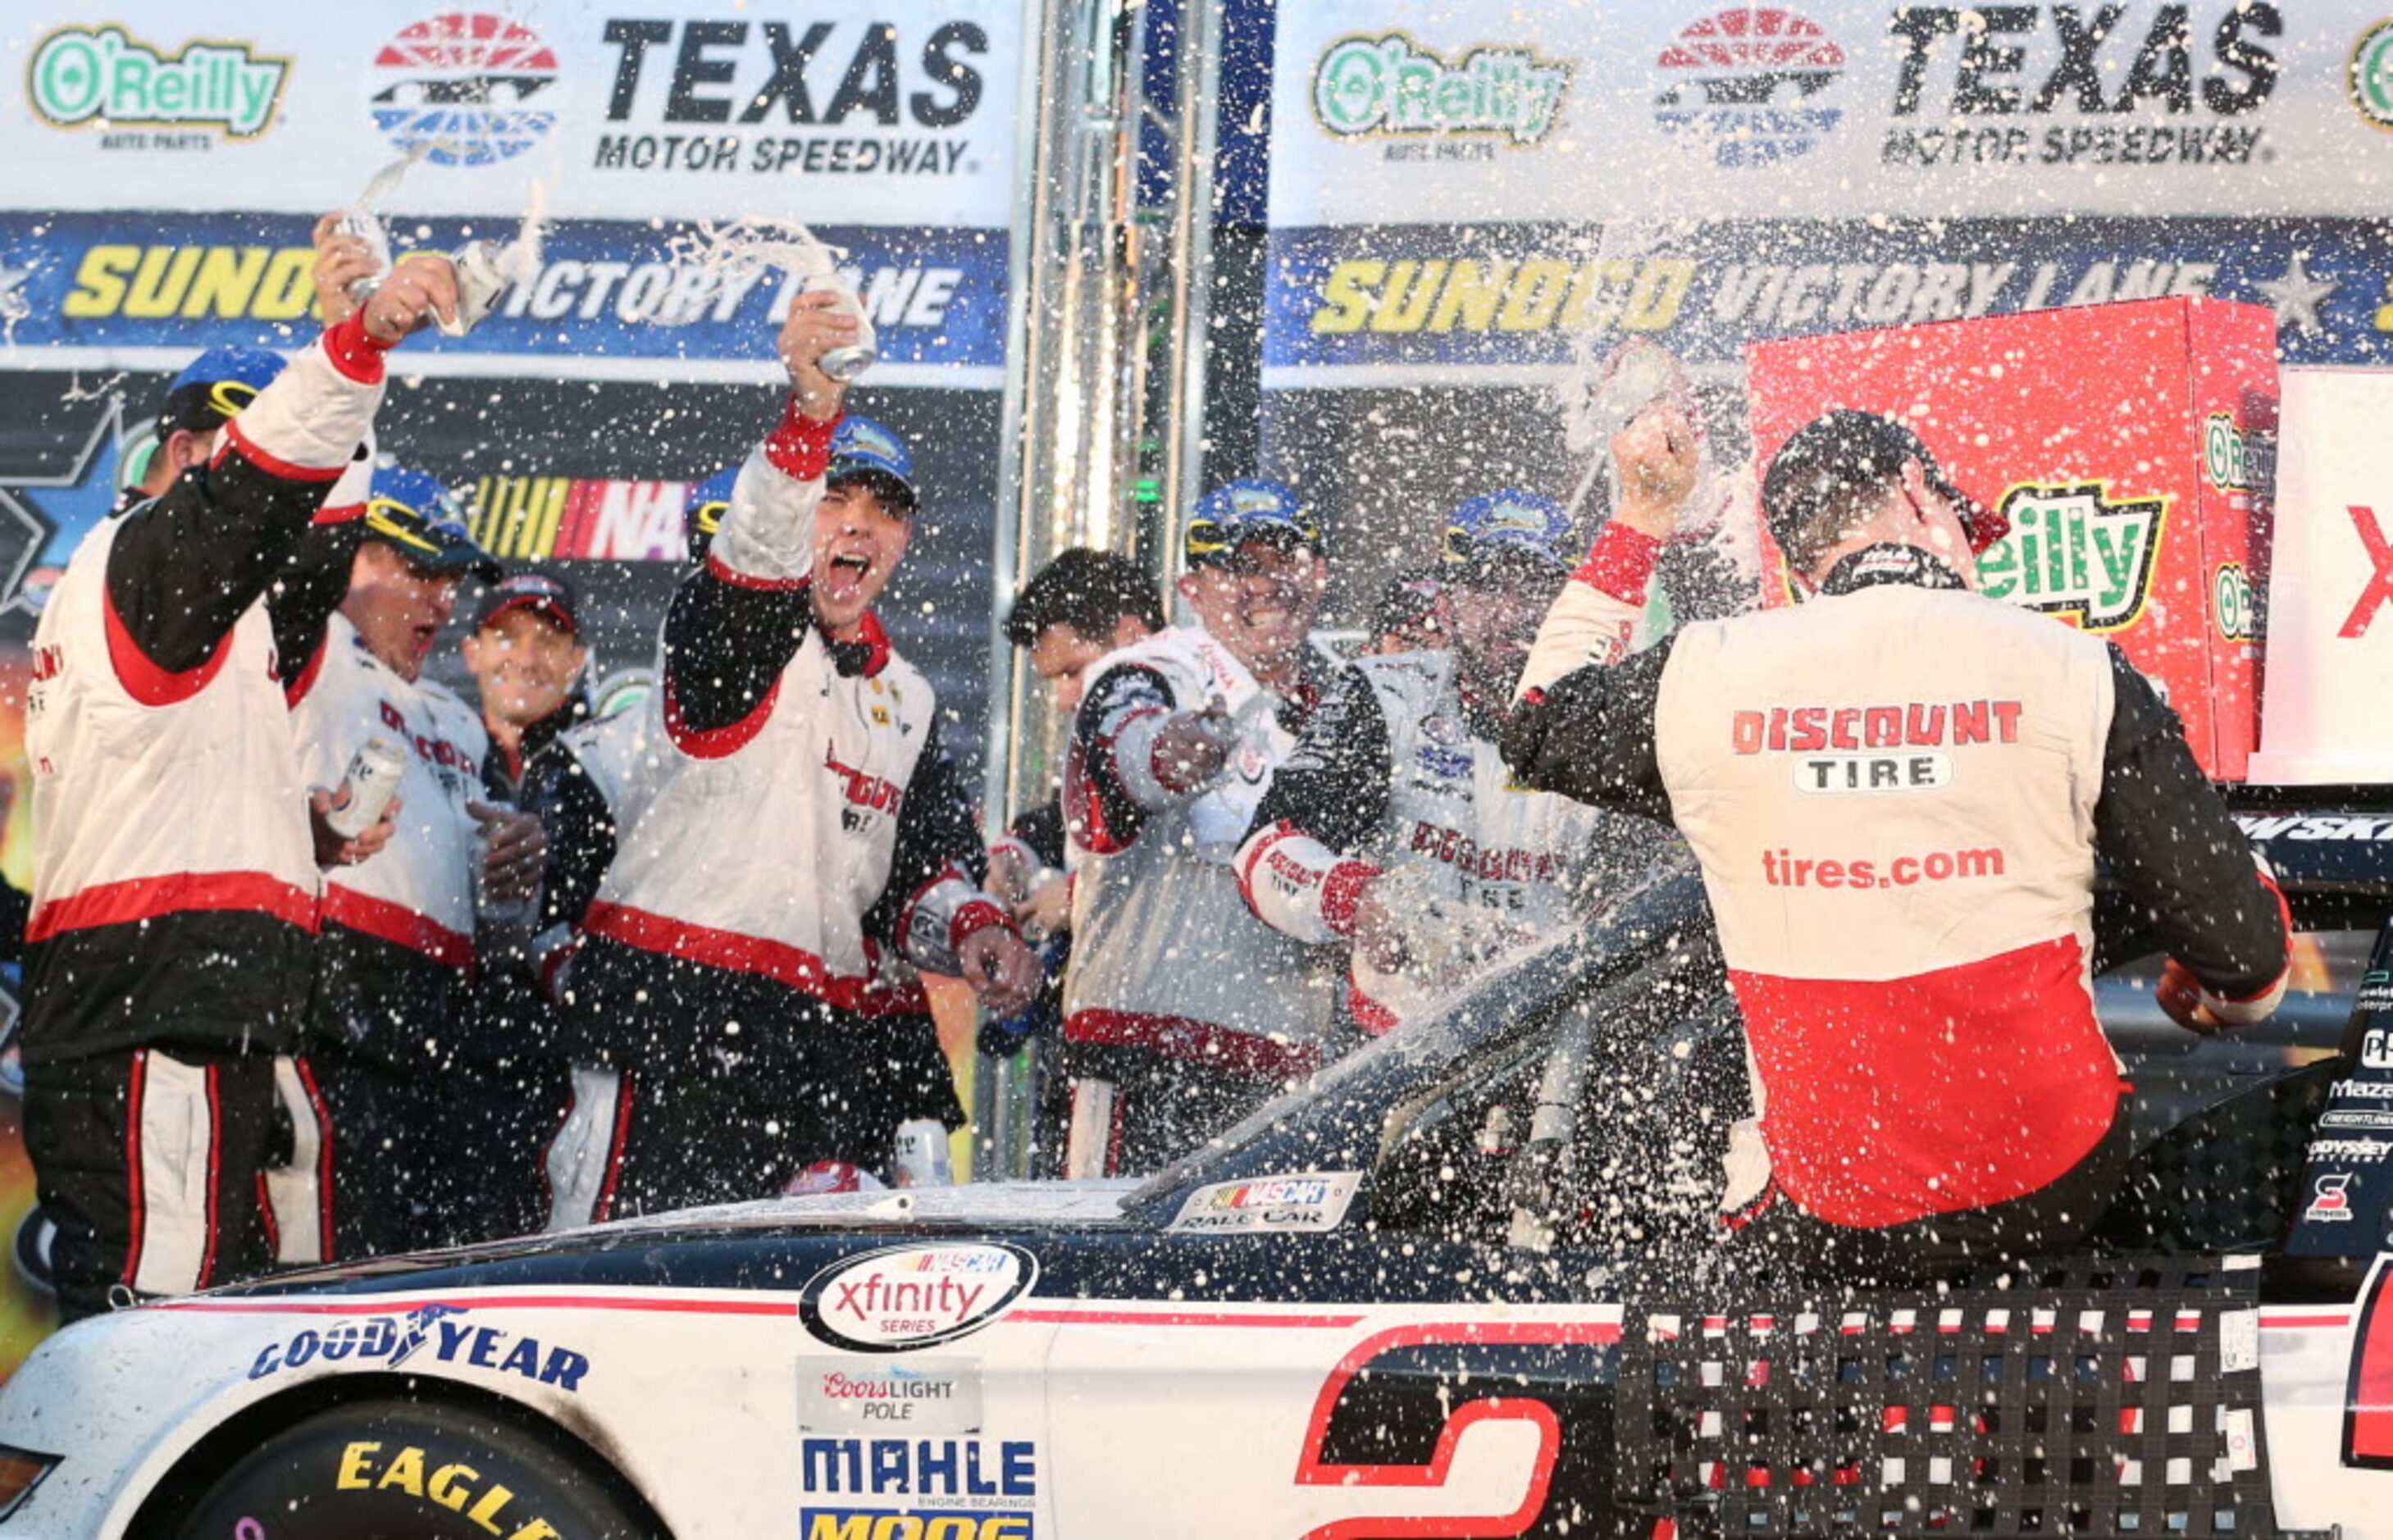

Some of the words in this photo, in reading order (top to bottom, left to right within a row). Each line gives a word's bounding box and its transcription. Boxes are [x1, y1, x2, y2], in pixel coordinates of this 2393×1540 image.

[41, 38, 273, 124] O'Reilly
[602, 18, 990, 128] TEXAS
[1887, 2, 2284, 116] TEXAS
[1327, 49, 1557, 130] O'Reilly
[153, 134, 211, 150] PARTS
[594, 135, 737, 171] MOTOR
[752, 138, 969, 175] SPEEDWAY
[1881, 126, 2030, 165] MOTOR
[2041, 126, 2263, 164] SPEEDWAY
[497, 261, 767, 325] ICTORY
[1312, 259, 1696, 334] SUNOCO
[1715, 261, 2014, 322] VICTORY
[1731, 699, 2022, 755] DISCOUNT
[1808, 757, 1936, 789] TIRE
[1762, 847, 2005, 890] tires.com
[1263, 1209, 1323, 1224] CAR
[836, 1271, 983, 1322] xfinity
[880, 1319, 937, 1333] SERIES
[862, 1401, 914, 1420] POLE
[801, 1438, 1037, 1497] MAHLE
[917, 1497, 967, 1508] ENGINE
[971, 1498, 1037, 1509] BEARINGS
